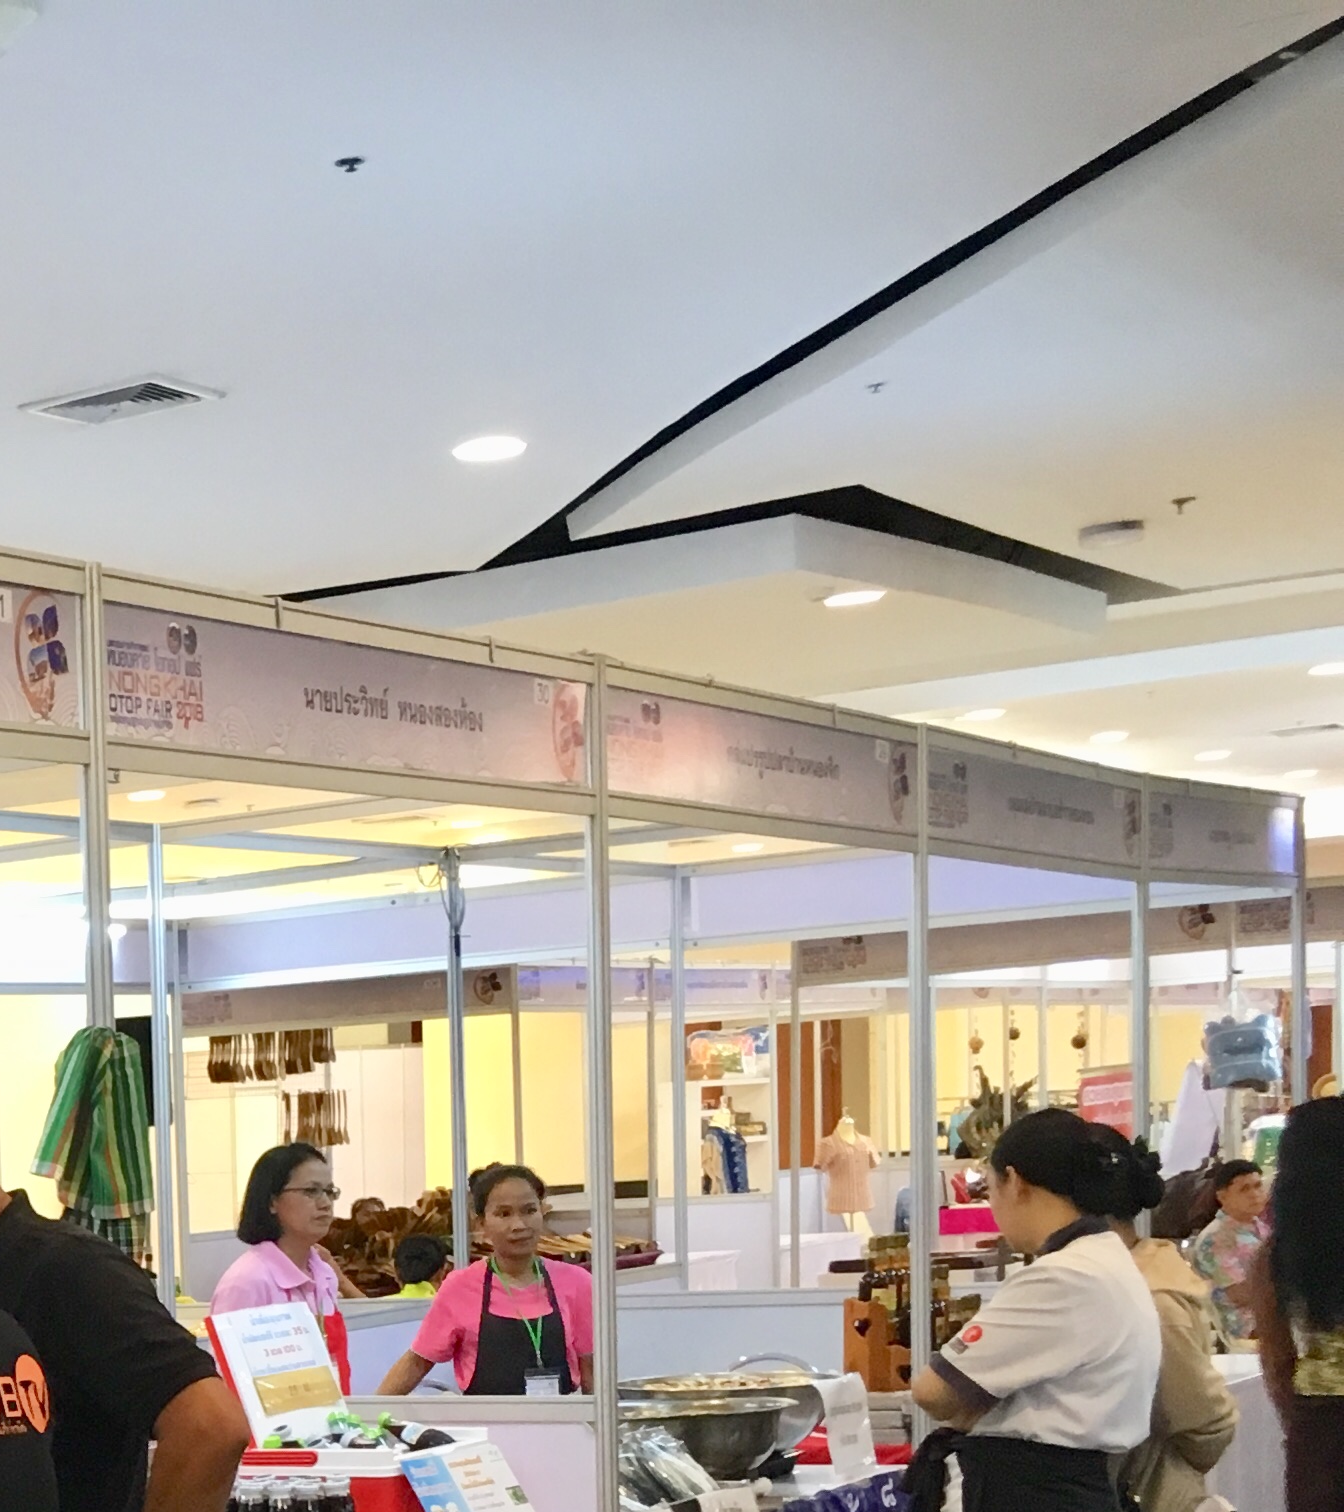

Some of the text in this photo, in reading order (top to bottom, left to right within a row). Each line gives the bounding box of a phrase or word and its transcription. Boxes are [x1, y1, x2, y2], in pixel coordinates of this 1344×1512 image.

[108, 670, 203, 701] NONG KHAI
[537, 683, 549, 704] 30
[109, 694, 203, 721] OTOP FAIR 2018
[303, 685, 483, 732] นายประวิทย์ หนองสองห้อง
